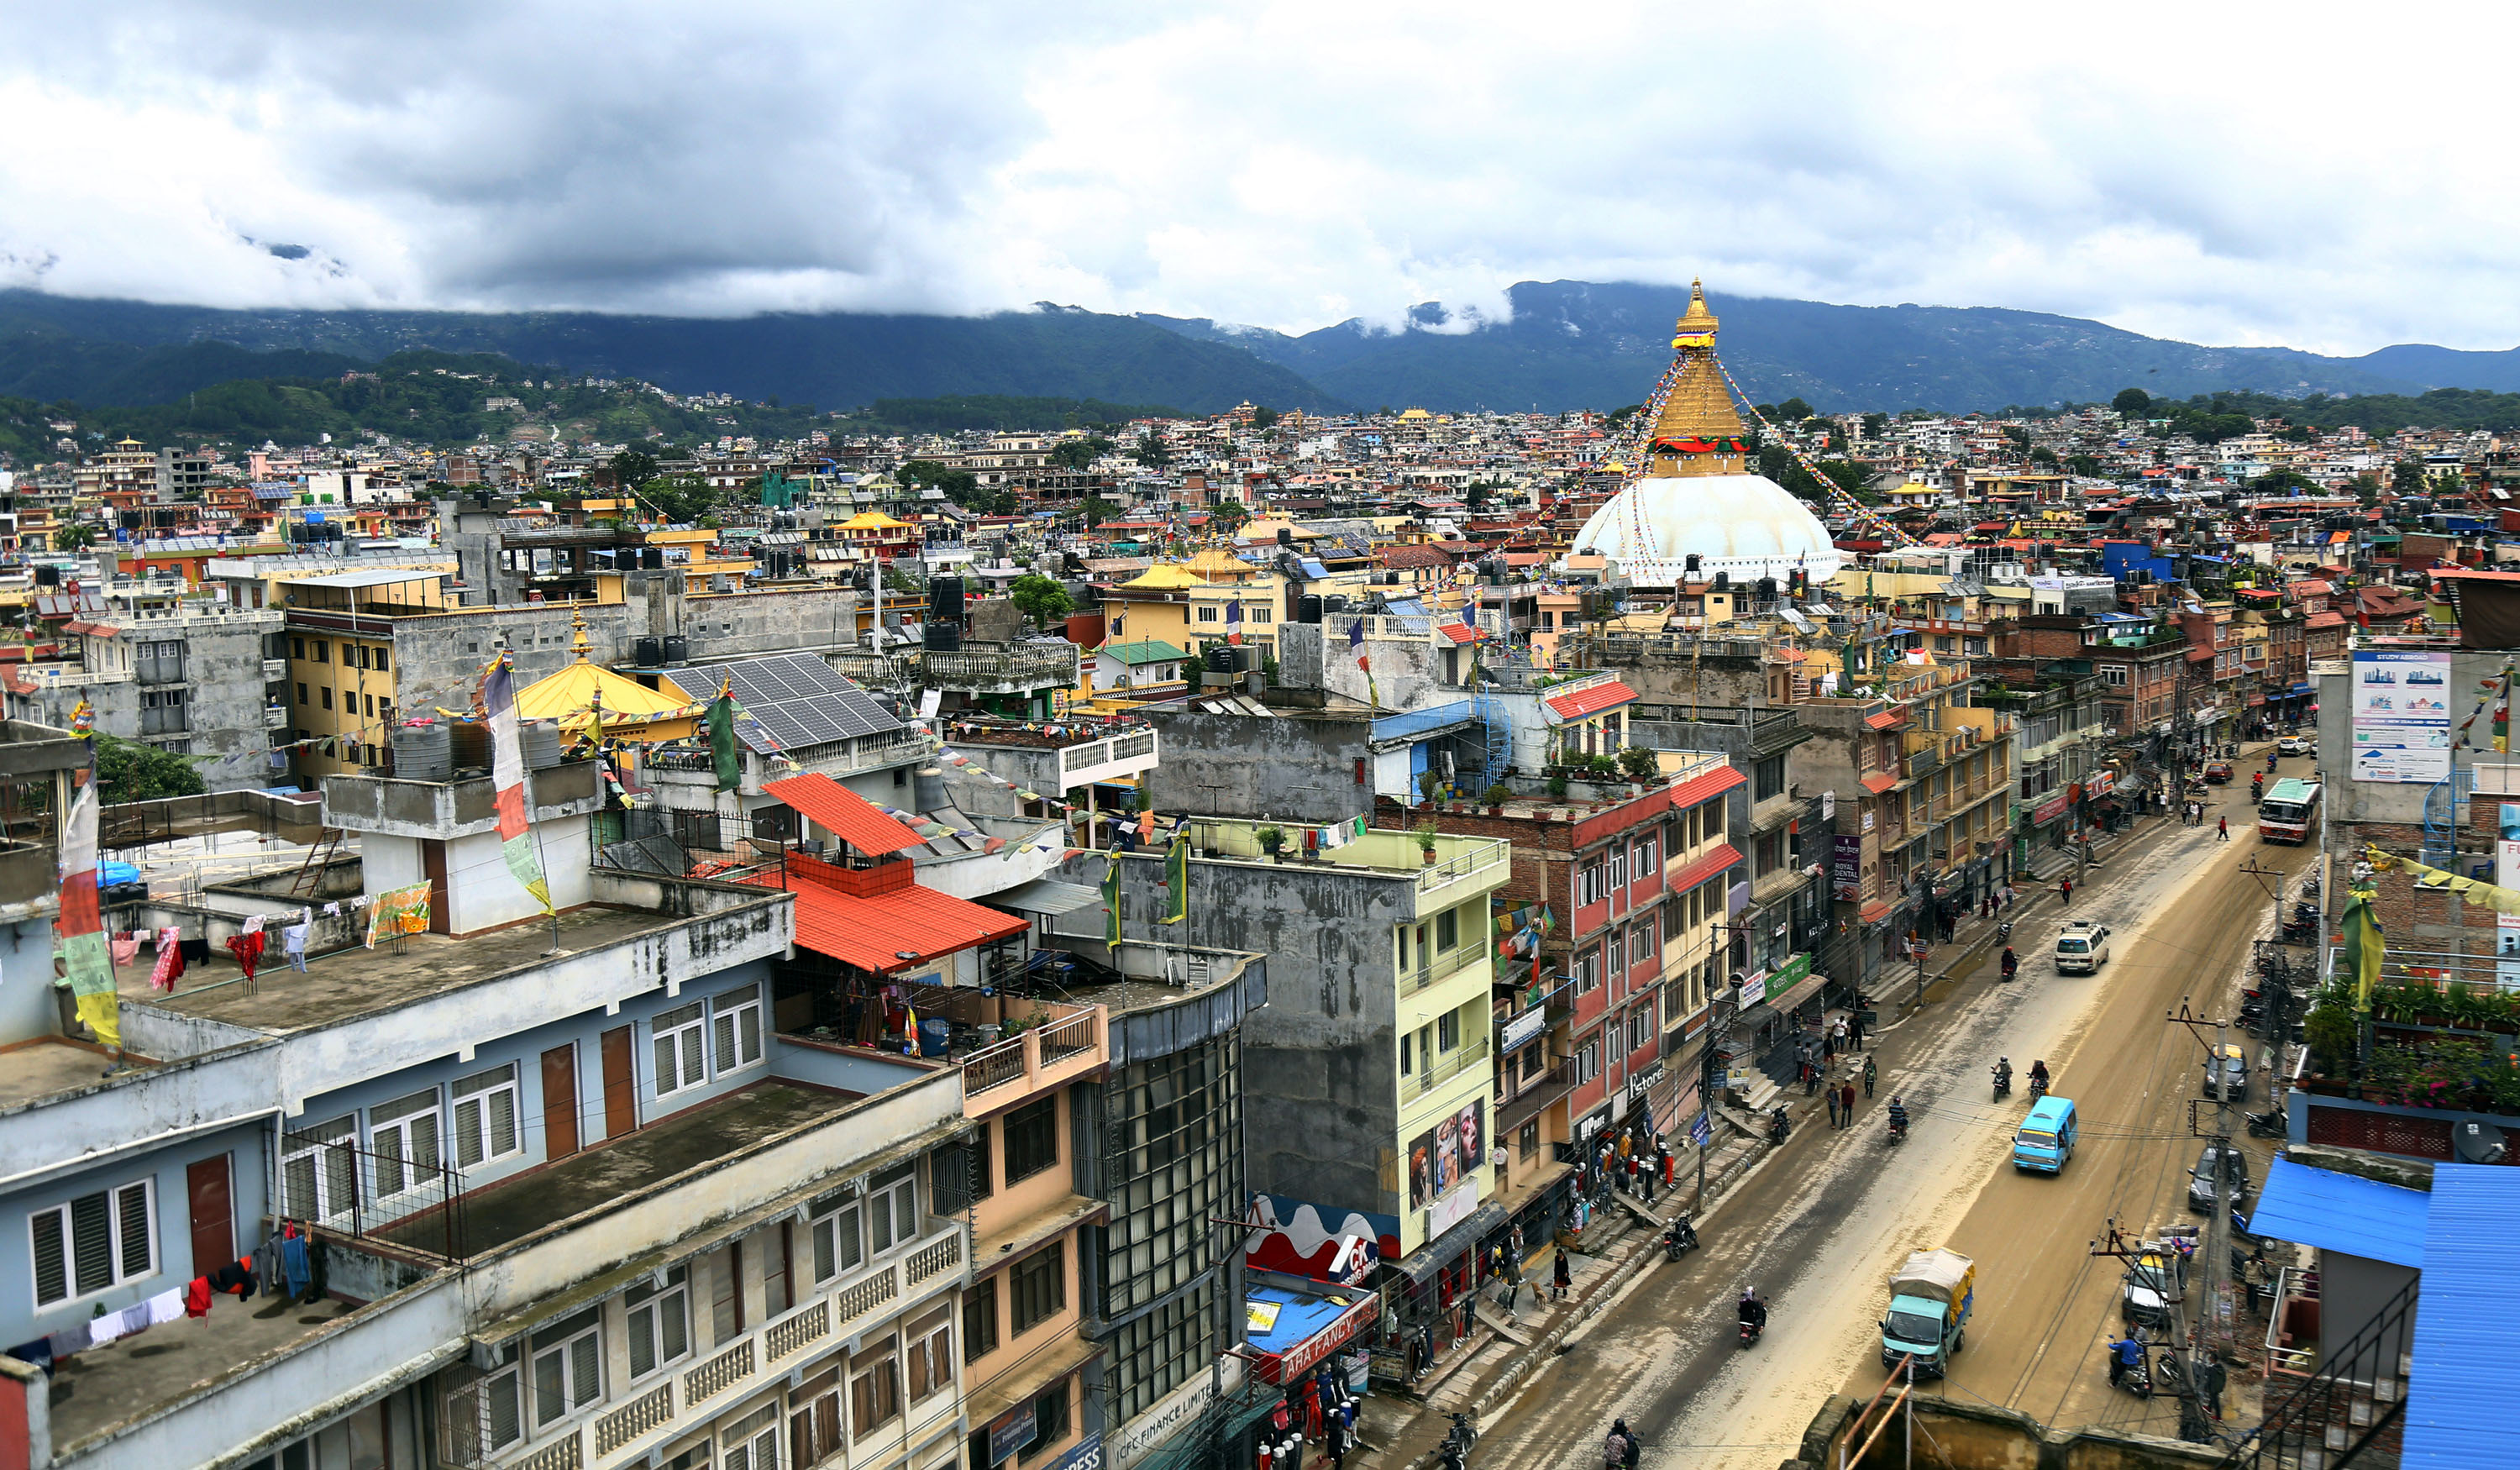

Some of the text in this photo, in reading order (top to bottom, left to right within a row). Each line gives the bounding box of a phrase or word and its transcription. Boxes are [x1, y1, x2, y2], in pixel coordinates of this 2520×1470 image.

[1835, 869, 1858, 879] DENTAL
[1349, 1241, 1368, 1271] CK
[1362, 1257, 1378, 1277] MALL
[1286, 1352, 1311, 1378] ARA
[1315, 1314, 1355, 1357] FANCY
[1116, 1436, 1140, 1465] ICFC
[1141, 1404, 1181, 1444] FINANCE
[1183, 1383, 1213, 1414] LIMITE
